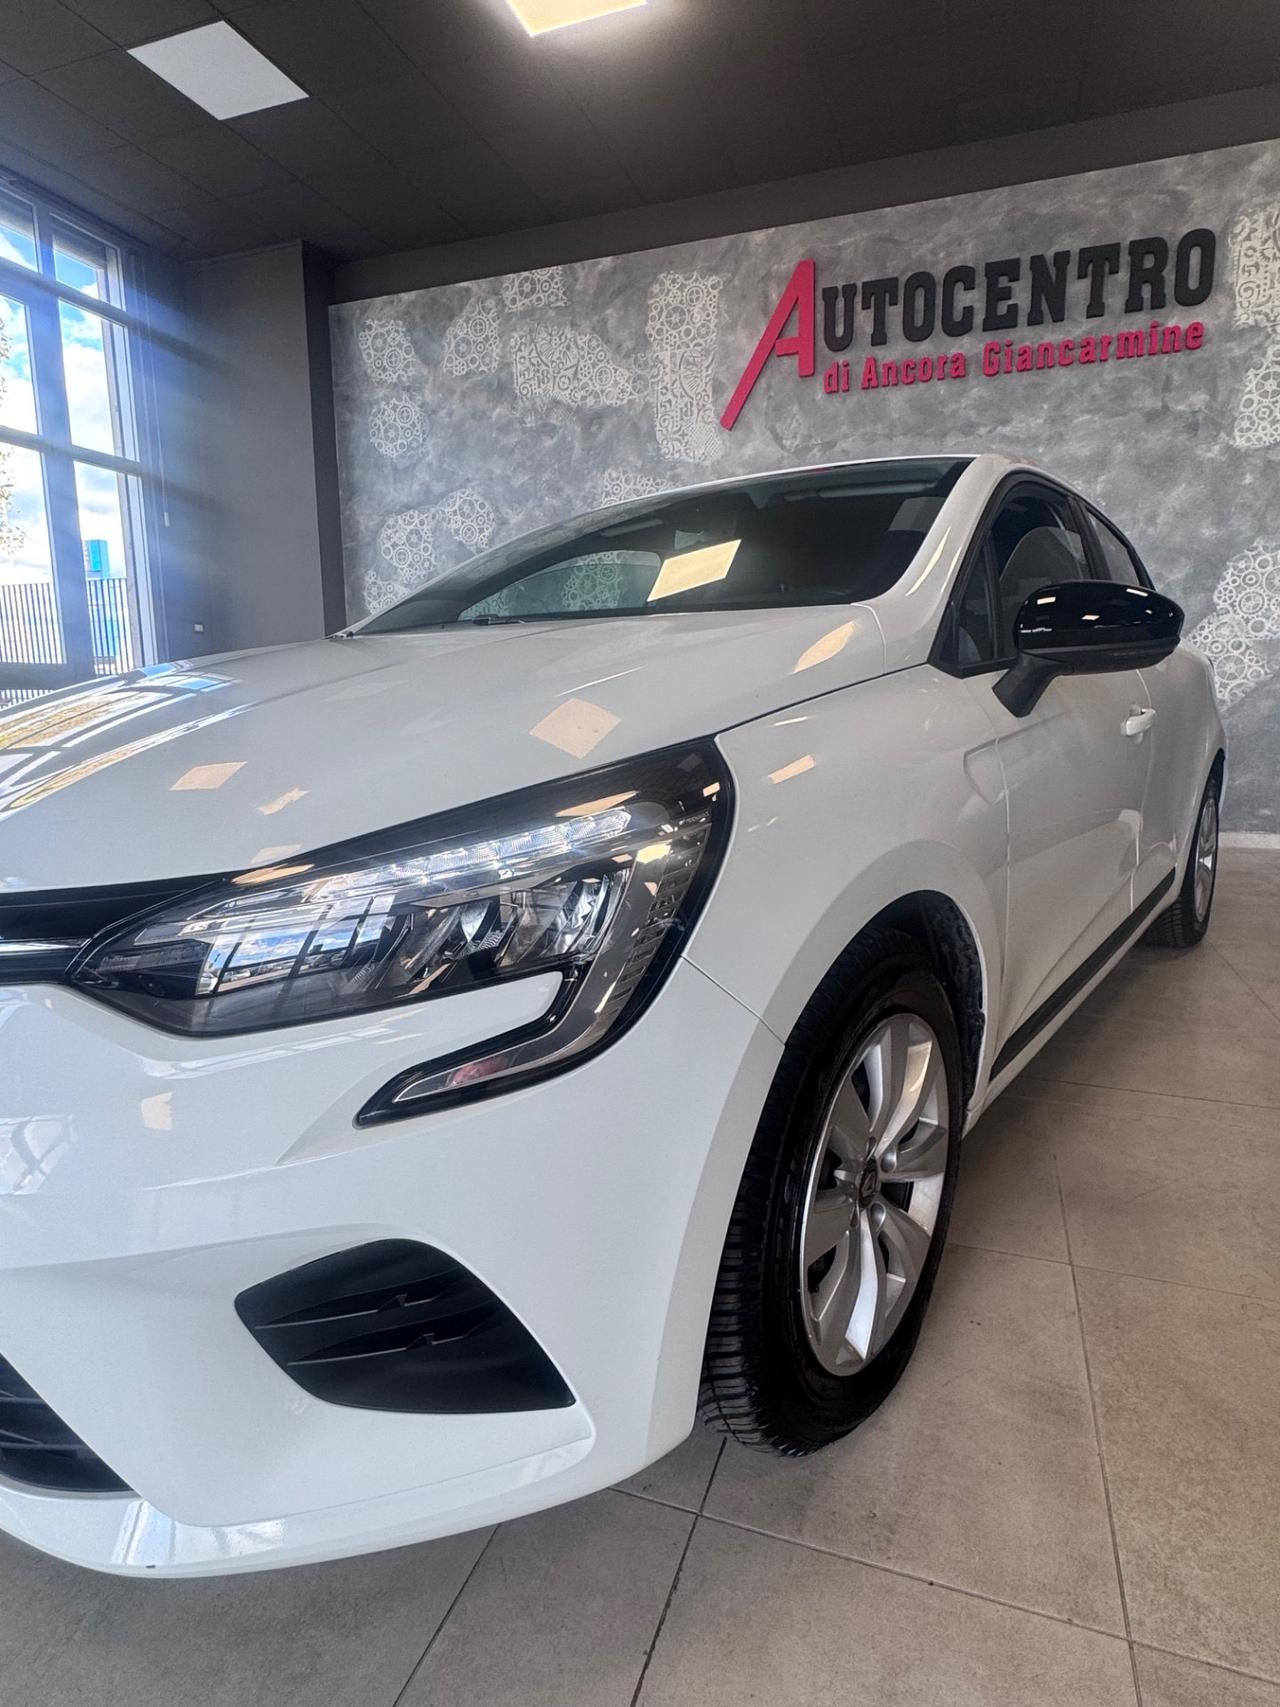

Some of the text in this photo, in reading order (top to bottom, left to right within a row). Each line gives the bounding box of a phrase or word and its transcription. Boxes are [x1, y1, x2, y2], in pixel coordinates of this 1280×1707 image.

[721, 228, 1217, 432] AUTOCENTRO
[823, 320, 1205, 393] di Ancora Giancarmine
